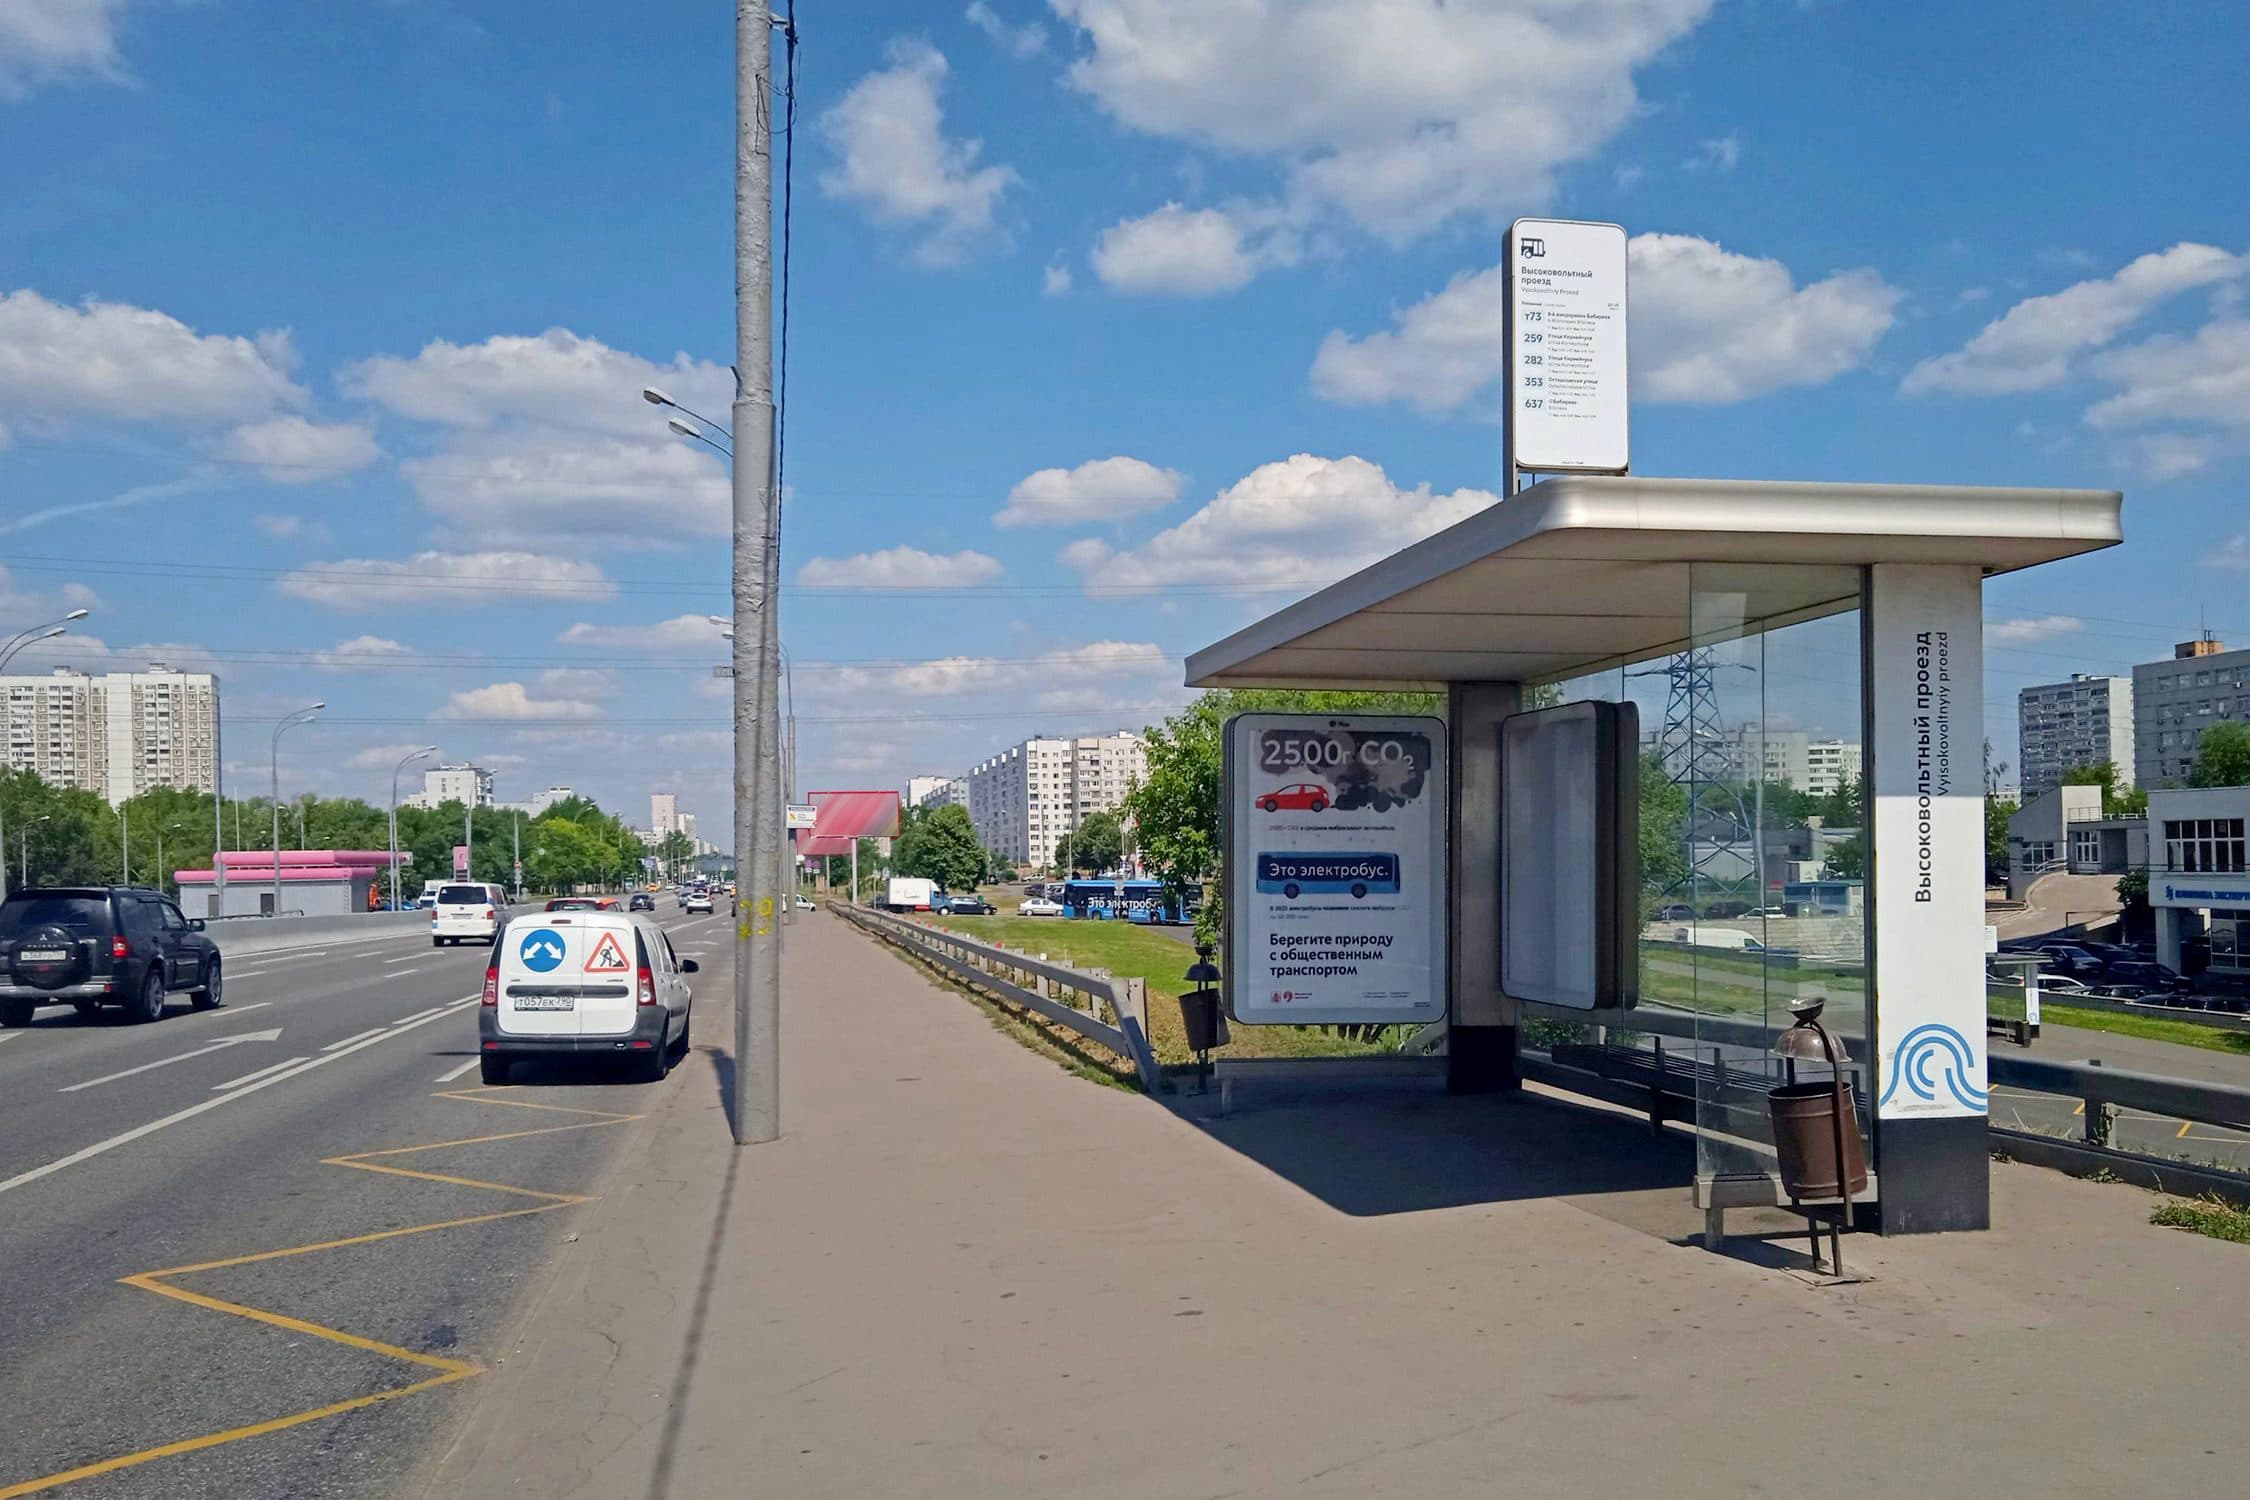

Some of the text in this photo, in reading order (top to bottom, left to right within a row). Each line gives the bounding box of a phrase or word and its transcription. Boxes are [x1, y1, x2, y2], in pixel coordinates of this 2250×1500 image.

[1521, 266, 1592, 278] Высоковольтный
[1521, 277, 1551, 286] проезд
[1524, 333, 1543, 343] 259
[1524, 355, 1543, 365] 282
[1525, 377, 1543, 387] 353
[1525, 399, 1543, 409] 637
[1936, 631, 1950, 681] proezd
[1913, 631, 1933, 903] Высоковольтный проезд
[1269, 863, 1388, 879] Это электробус.
[1088, 896, 1105, 908] Это
[1270, 933, 1394, 948] Берегите природу
[1270, 948, 1383, 962] с общественным
[1270, 966, 1358, 978] транспортом
